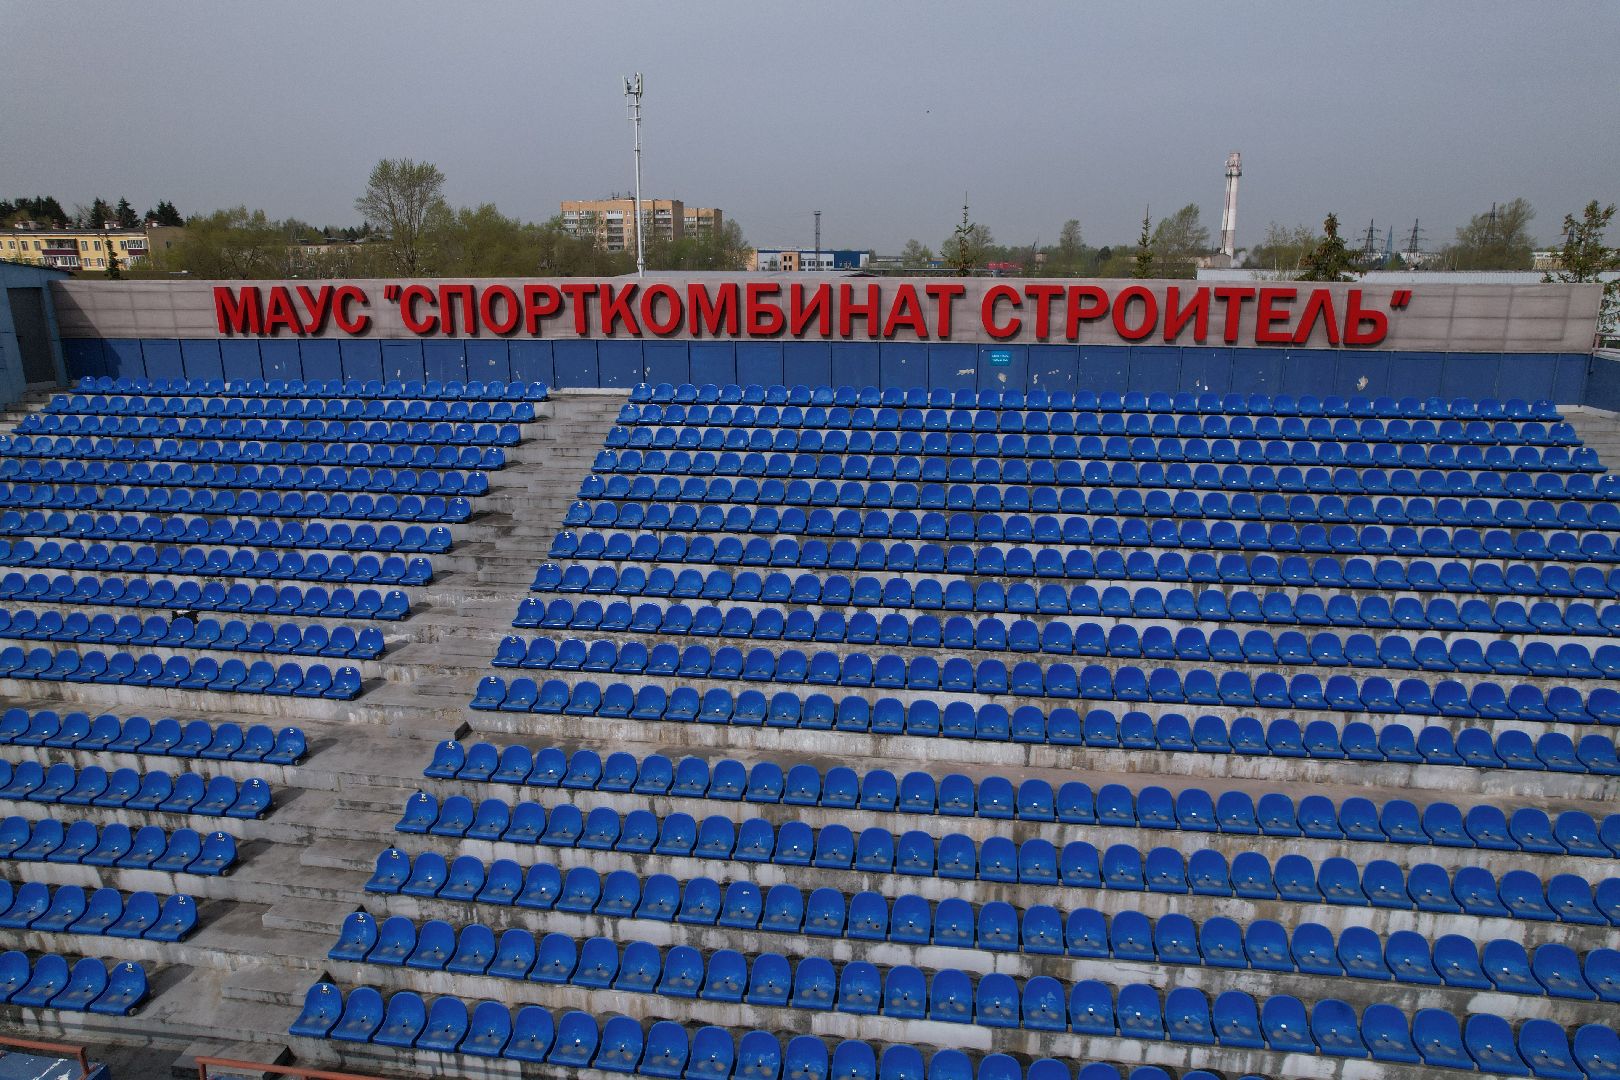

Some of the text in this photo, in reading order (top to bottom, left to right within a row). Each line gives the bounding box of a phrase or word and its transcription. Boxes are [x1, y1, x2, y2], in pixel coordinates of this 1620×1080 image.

[213, 282, 1412, 344] МАУС "СПОРТКОМБИНАТ СТРОИТЕЛЬ"
